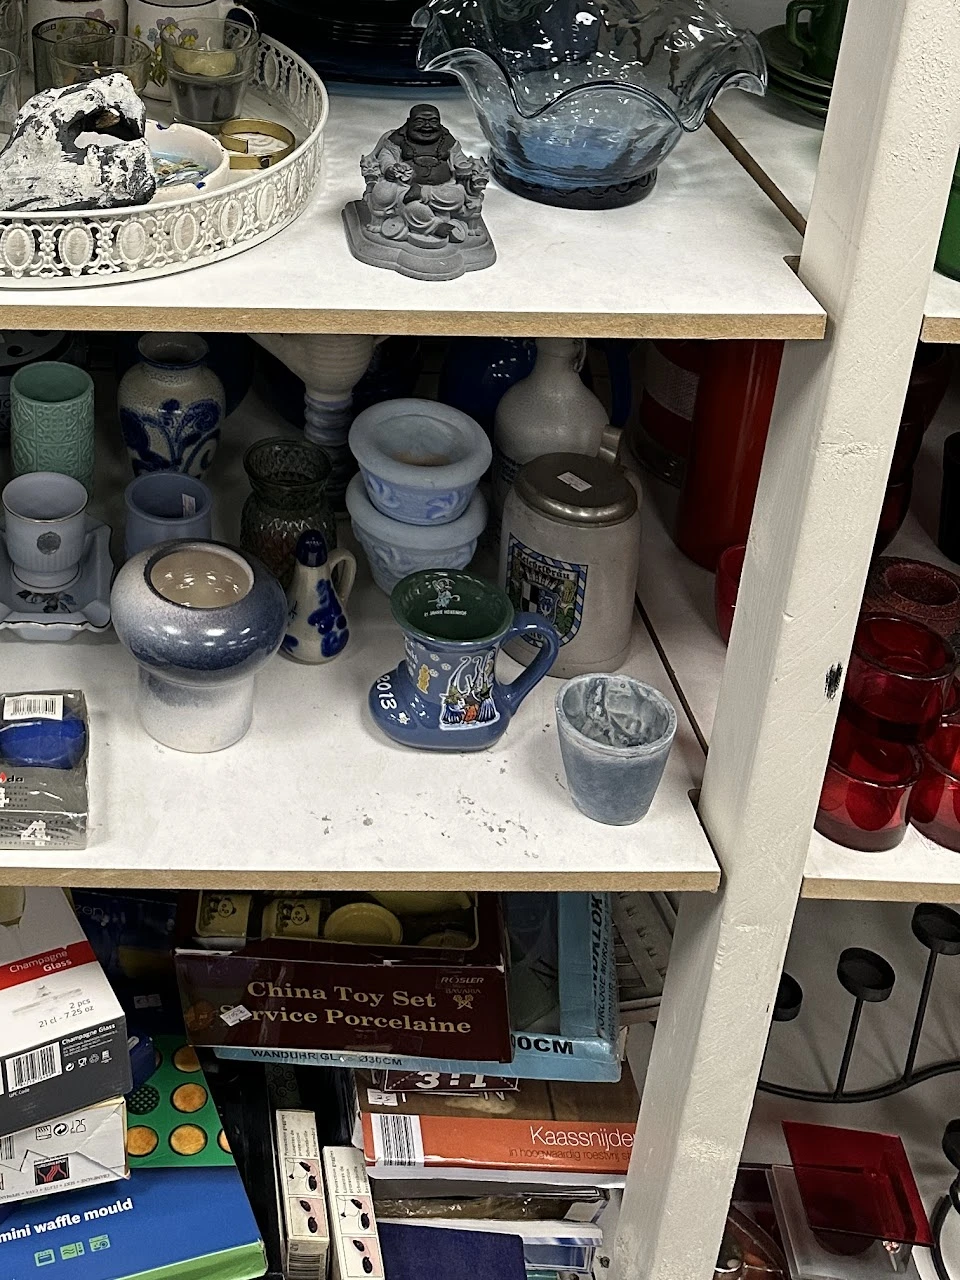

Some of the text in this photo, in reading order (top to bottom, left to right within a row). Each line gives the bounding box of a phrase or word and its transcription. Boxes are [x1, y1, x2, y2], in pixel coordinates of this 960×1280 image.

[376, 674, 398, 710] 2013
[20, 820, 51, 847] 4
[9, 949, 68, 973] Champagne
[43, 958, 72, 973] Glass
[77, 998, 91, 1009] pcs
[246, 980, 437, 1008] China Toy Set
[38, 1019, 48, 1028] 21
[49, 1016, 57, 1025] cl
[84, 1005, 95, 1014] oz
[219, 1004, 318, 1024] Srvice
[324, 1008, 472, 1034] Porcelaine
[61, 1027, 98, 1046] Champagne
[98, 1022, 116, 1034] Glass
[251, 1049, 318, 1061] WANDUHR
[18, 1087, 31, 1096] Code
[530, 1125, 635, 1152] Kaassnijde
[329, 1150, 337, 1168] goggles
[509, 1147, 518, 1158] in
[34, 1214, 81, 1234] waffle
[84, 1197, 134, 1221] mould
